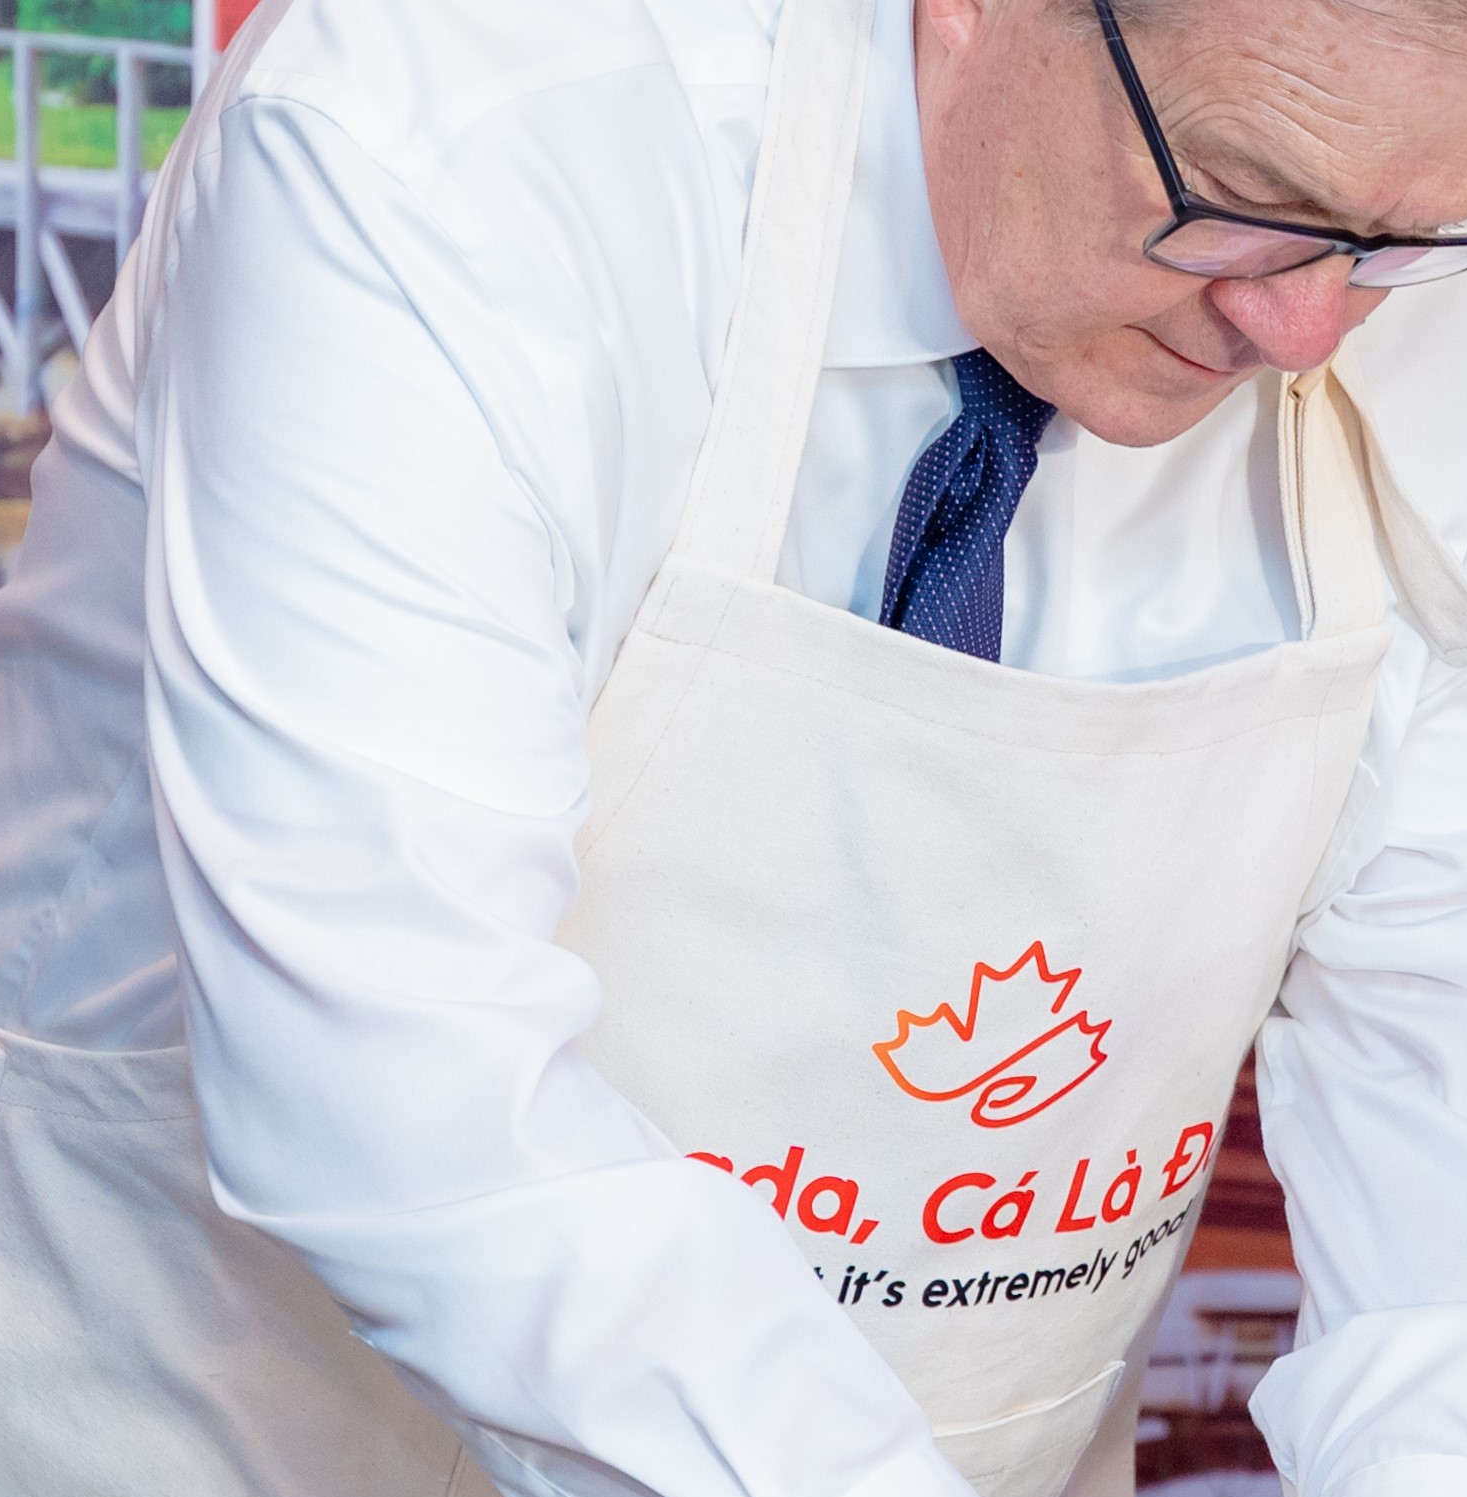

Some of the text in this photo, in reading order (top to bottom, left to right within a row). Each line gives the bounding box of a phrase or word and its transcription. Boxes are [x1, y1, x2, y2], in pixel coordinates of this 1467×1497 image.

[684, 1120, 1222, 1245] da, Cá Là Đ
[838, 1265, 906, 1307] it's
[921, 1248, 1119, 1308] extremely
